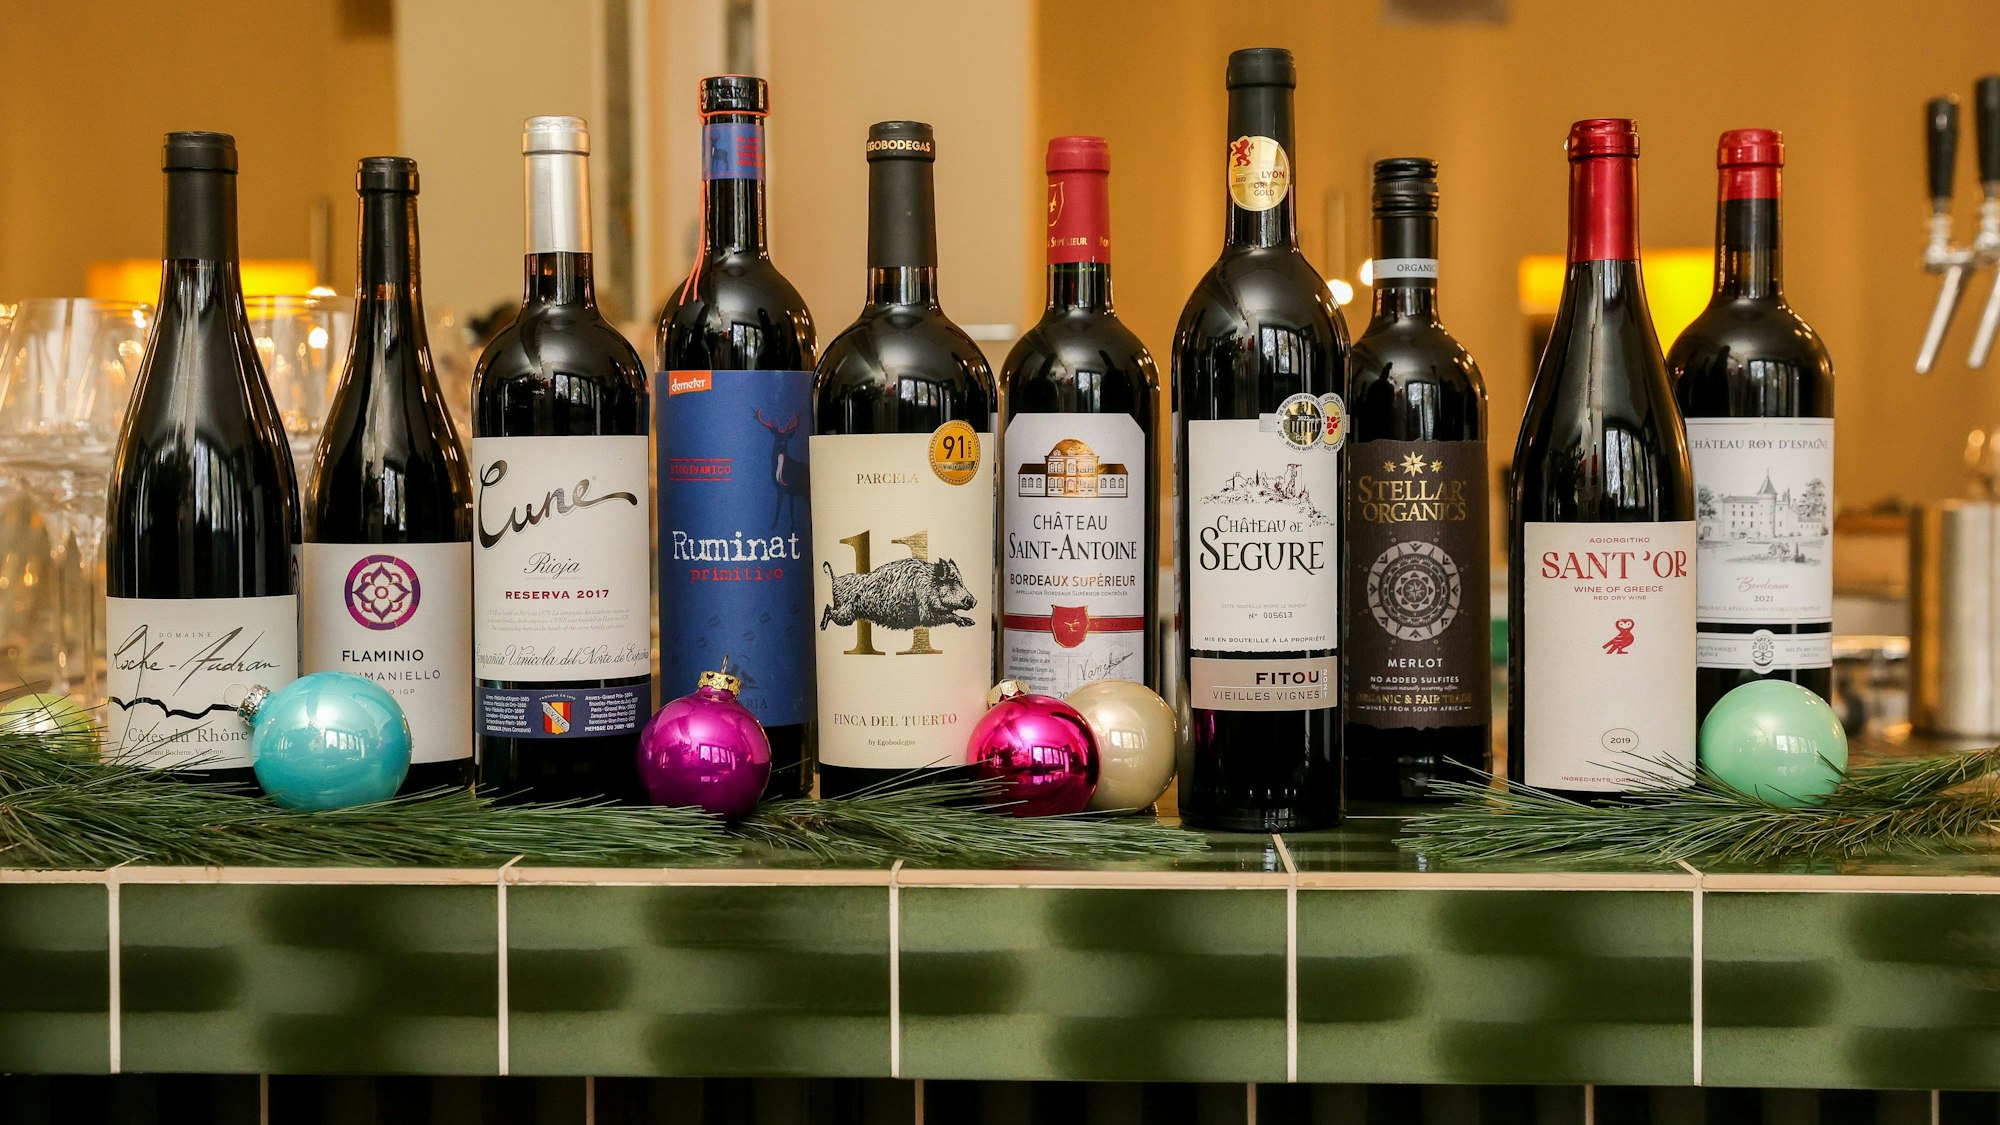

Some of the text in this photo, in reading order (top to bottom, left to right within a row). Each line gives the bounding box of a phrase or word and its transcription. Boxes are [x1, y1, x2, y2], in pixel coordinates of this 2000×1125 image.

[671, 378, 706, 392] demeter
[943, 435, 964, 459] 91
[1286, 441, 1301, 451] BERLIN
[1749, 440, 1774, 449] ROY
[856, 473, 919, 484] PARCELA
[1358, 476, 1466, 503] STELLAR
[478, 459, 638, 550] Cune
[1362, 502, 1466, 523] ORGANICS
[1033, 511, 1108, 530] CHÂTEAU
[672, 530, 800, 561] Ruminat
[1200, 527, 1324, 575] SEGURE
[523, 552, 581, 580] Rioja
[690, 566, 784, 583] primitivo
[1010, 573, 1136, 587] BORDEAUX SUPÉRIEUR
[1624, 585, 1663, 593] GREECE
[1737, 576, 1790, 592] Bordeaux
[505, 589, 609, 600] RESERVA 2017
[839, 529, 943, 655] 11
[1263, 611, 1293, 619] 005613
[342, 649, 424, 662] FLAMINIO
[505, 644, 556, 666] Vinícola
[558, 648, 583, 666] del
[581, 645, 612, 665] Norte
[612, 646, 625, 663] de
[1388, 658, 1443, 667] MERLOT
[1256, 671, 1319, 685] FITOU
[1386, 676, 1417, 684] ADDED
[1421, 676, 1459, 684] SULFITES
[1213, 690, 1320, 701] VIEILLES VIGNES
[1404, 694, 1412, 704] &
[1415, 694, 1440, 704] FAIR
[834, 714, 957, 727] FINCA DEL TUERTO
[128, 726, 248, 743] Côtes du Rhône
